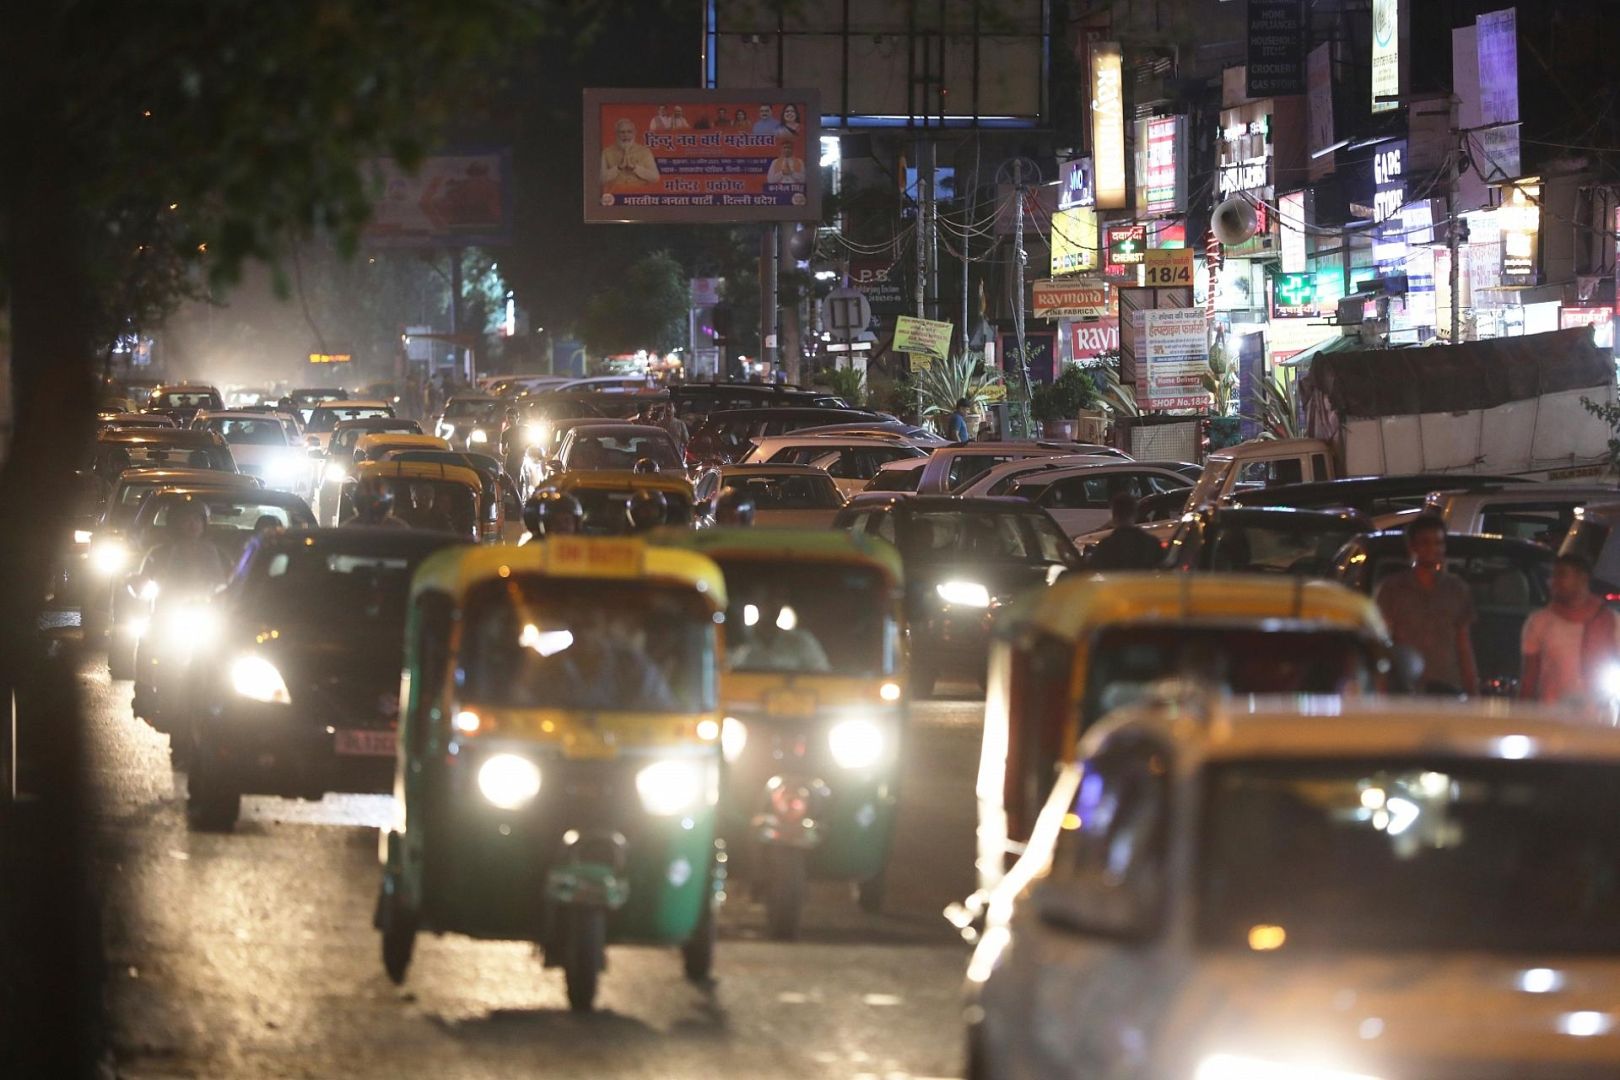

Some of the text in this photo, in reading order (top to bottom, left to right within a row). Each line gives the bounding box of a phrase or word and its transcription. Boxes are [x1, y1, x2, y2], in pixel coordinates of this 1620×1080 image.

[1148, 267, 1190, 283] 18/4
[1038, 290, 1101, 306] Raymond
[1151, 399, 1175, 408] SHOP
